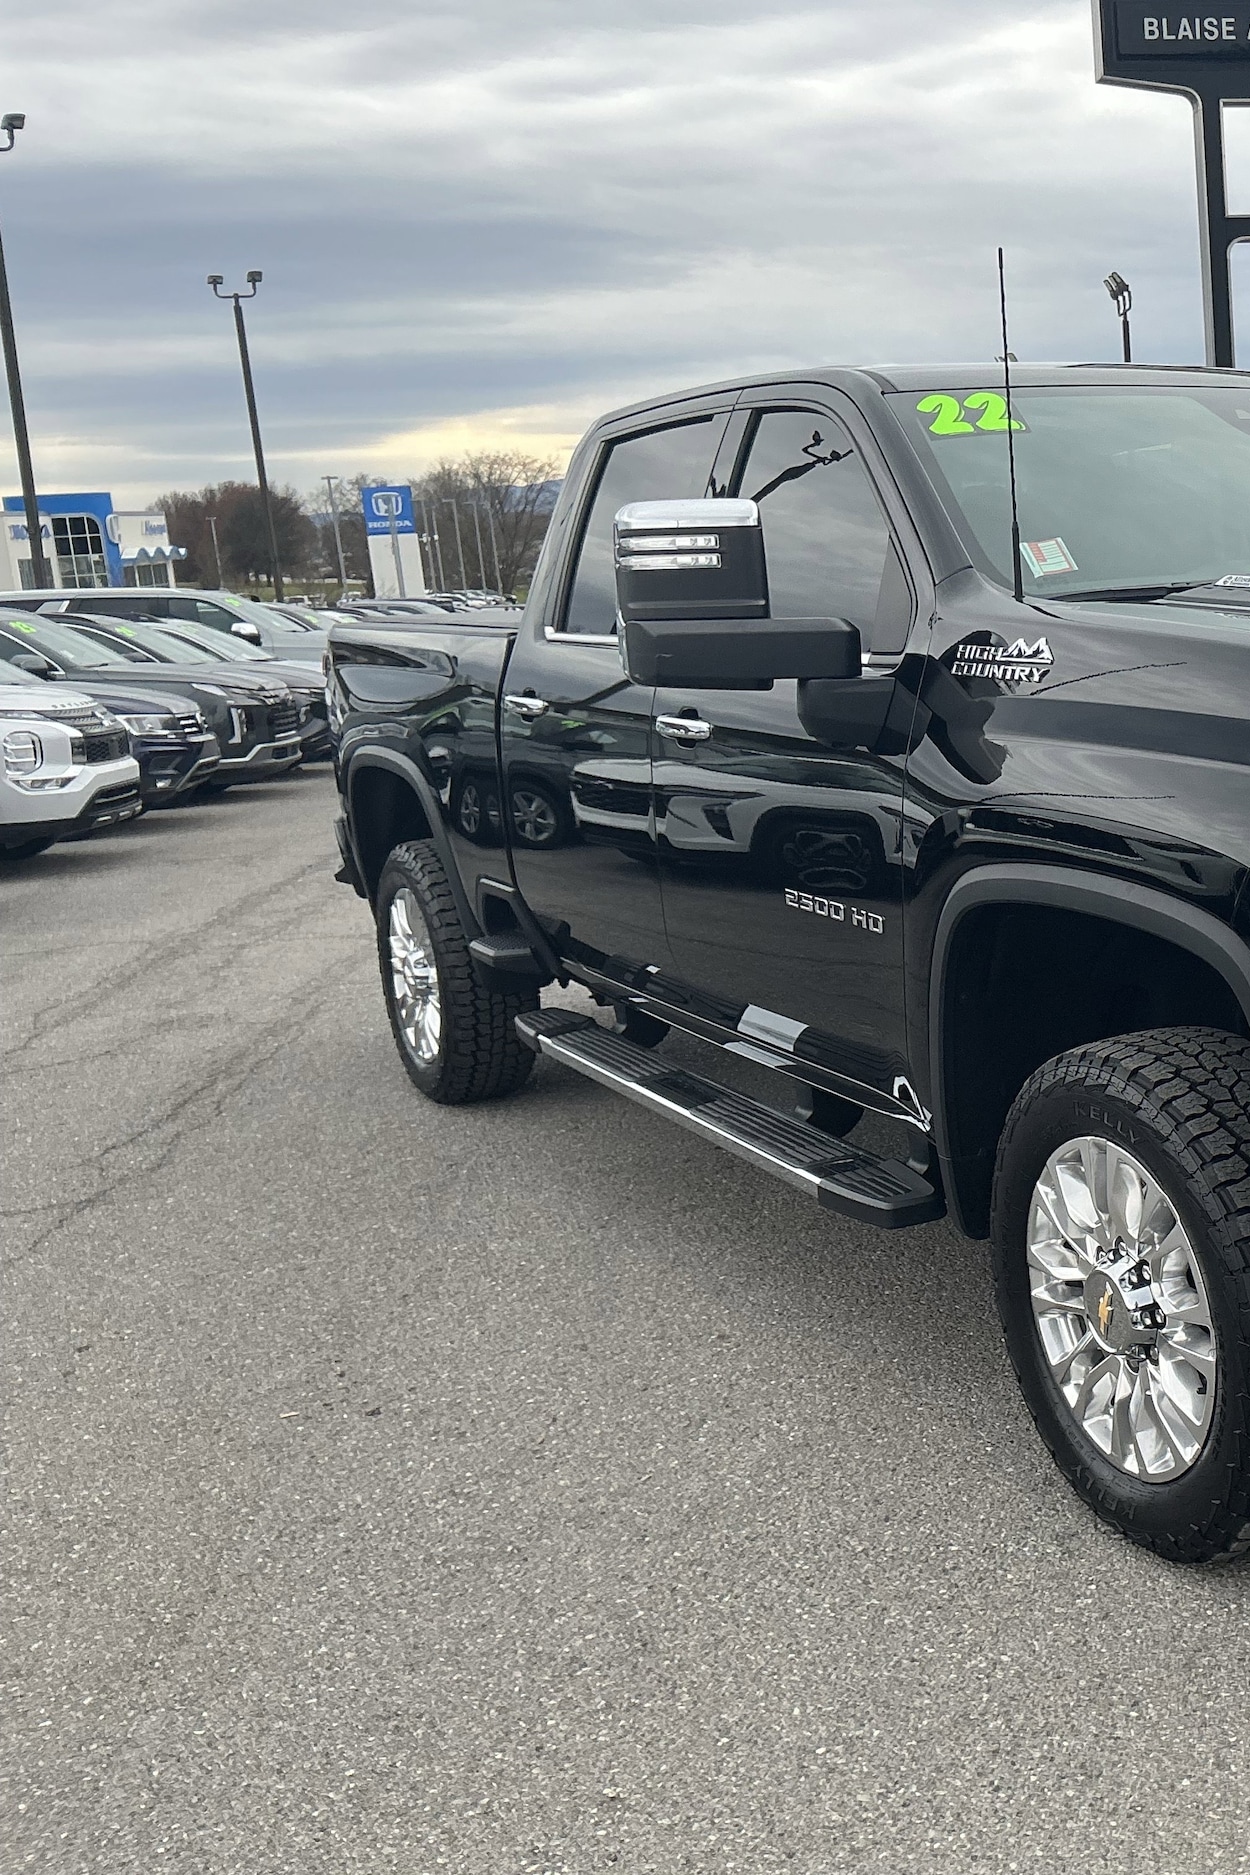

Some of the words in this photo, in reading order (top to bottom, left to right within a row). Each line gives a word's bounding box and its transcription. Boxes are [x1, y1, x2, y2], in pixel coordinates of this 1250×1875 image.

[1143, 17, 1237, 40] BLAISE
[916, 391, 1026, 435] 22
[956, 644, 1004, 661] HIGH
[950, 661, 1051, 683] COUNTRY
[784, 887, 845, 922] 2500
[851, 906, 884, 934] HD
[1072, 1099, 1141, 1145] KELLY
